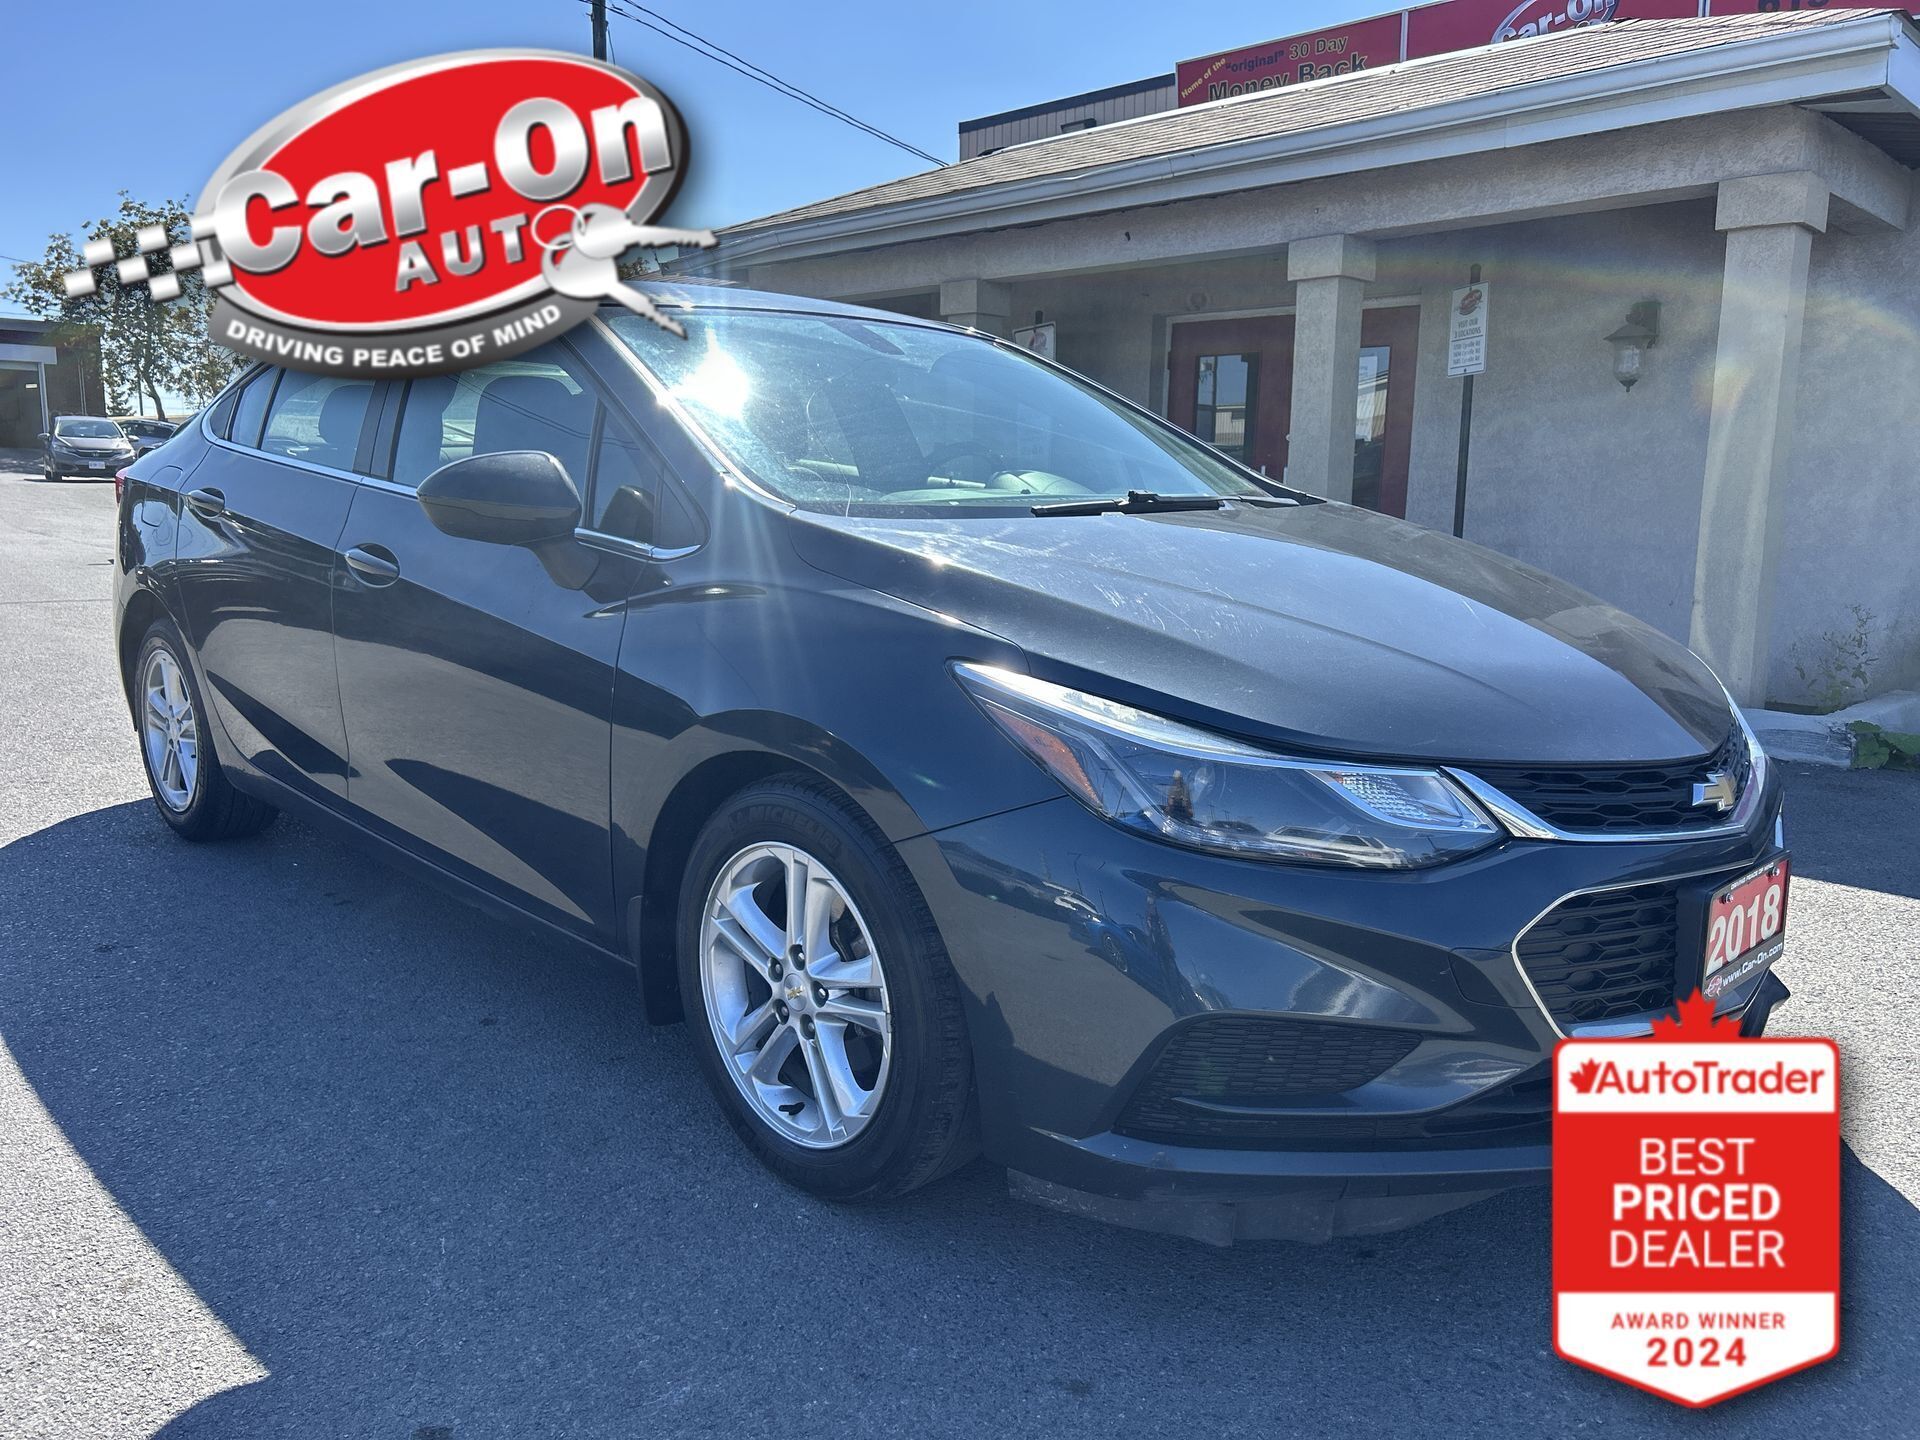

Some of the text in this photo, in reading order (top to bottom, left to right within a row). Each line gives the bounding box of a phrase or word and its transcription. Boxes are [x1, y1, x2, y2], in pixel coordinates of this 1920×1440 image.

[1289, 41, 1311, 60] 30
[1315, 35, 1348, 55] Day
[1181, 58, 1226, 98] Home of the
[1208, 52, 1367, 101] Money Back
[1706, 884, 1781, 977] 2018
[1722, 942, 1783, 987] www.Car-On.com
